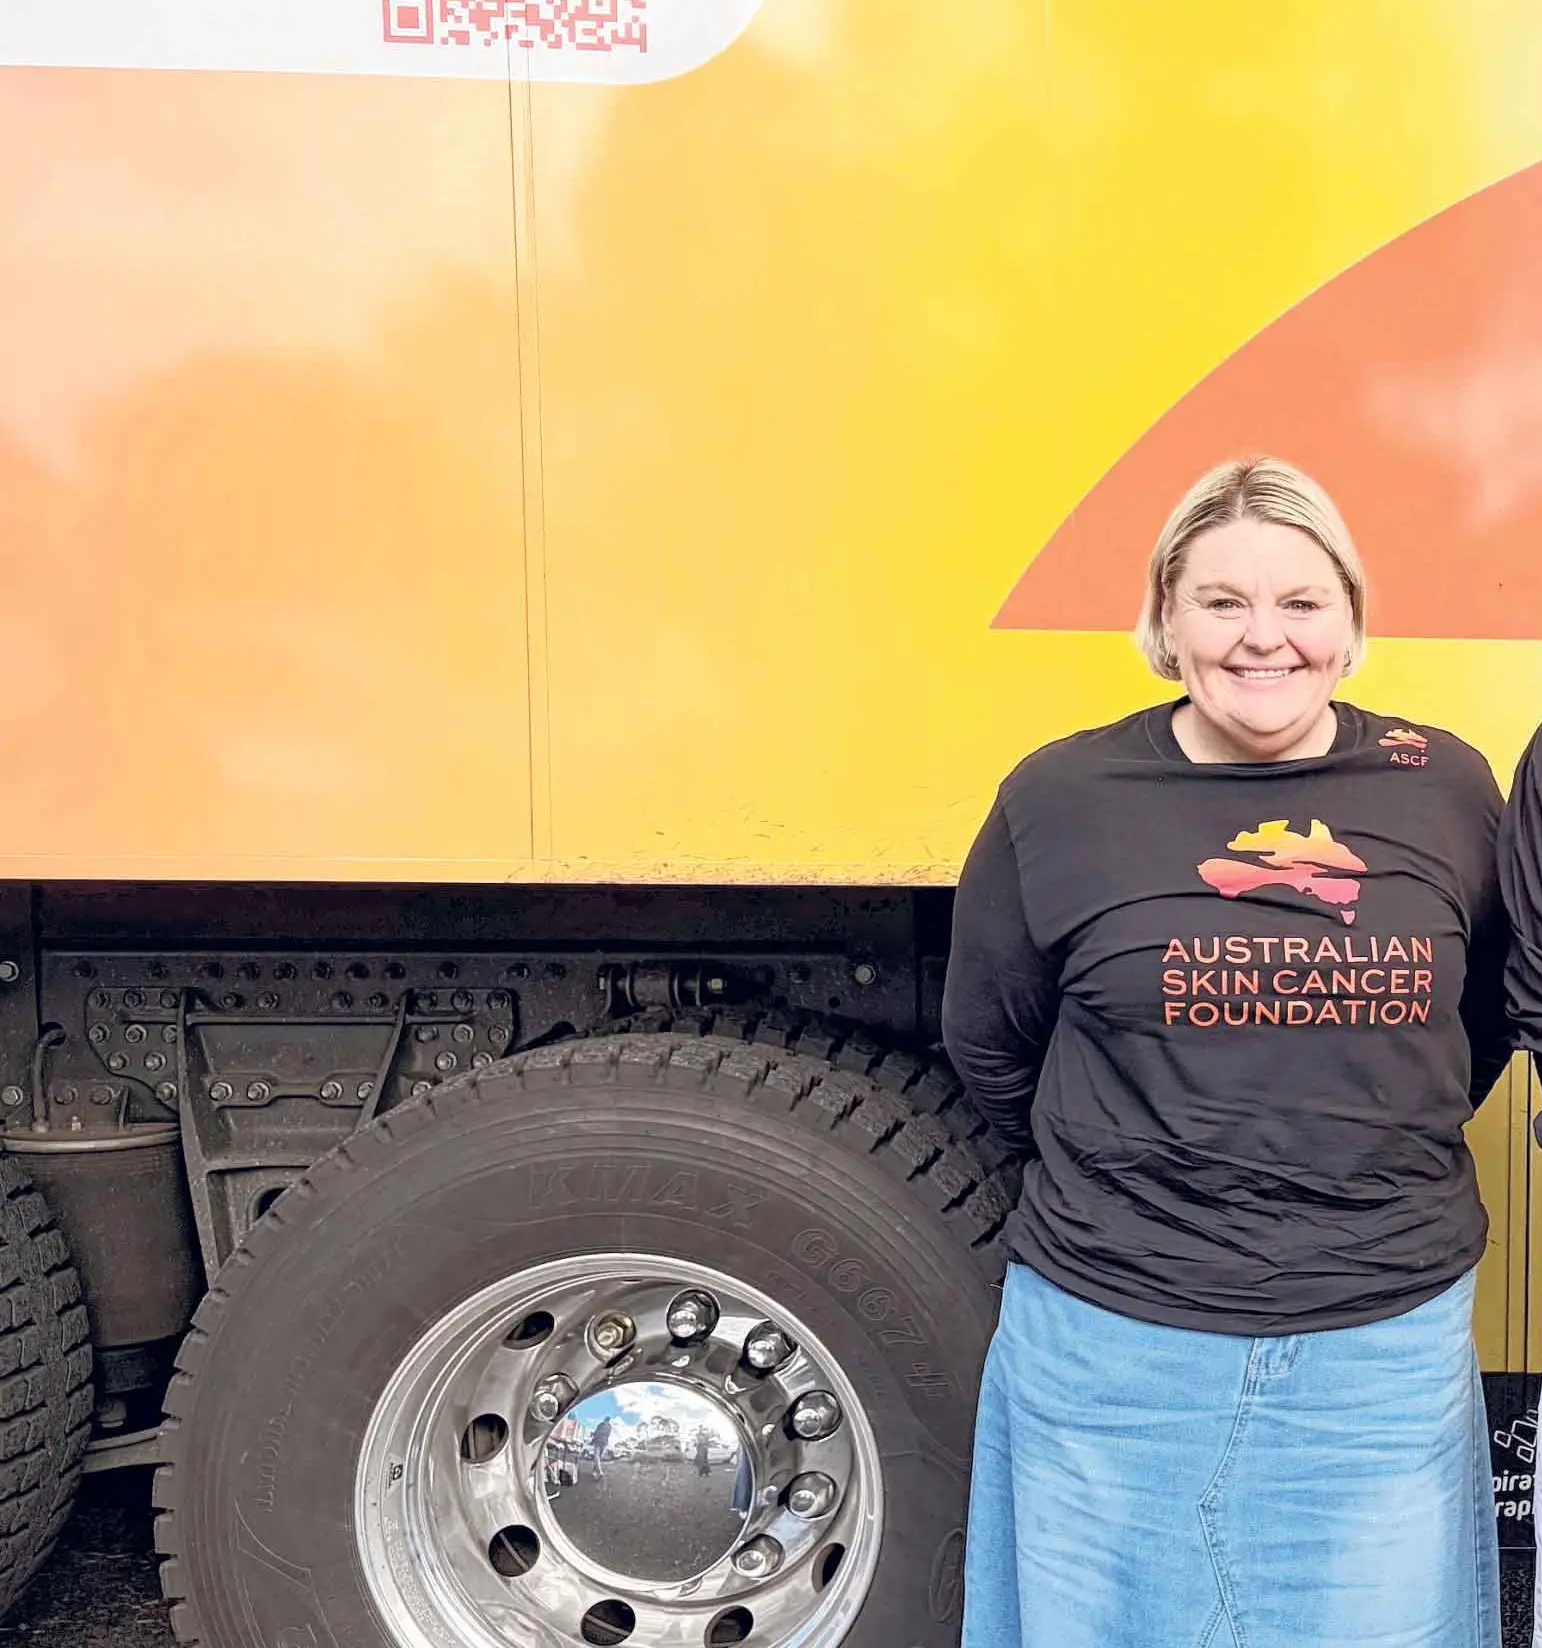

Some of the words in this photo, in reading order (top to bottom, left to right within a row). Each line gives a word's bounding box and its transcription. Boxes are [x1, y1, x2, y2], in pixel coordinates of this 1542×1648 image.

[1389, 752, 1431, 767] ASCF
[1161, 936, 1433, 964] AUSTRALIAN
[1161, 968, 1259, 997] SKIN
[1271, 968, 1433, 996] CANCER
[1163, 999, 1432, 1028] FOUNDATION
